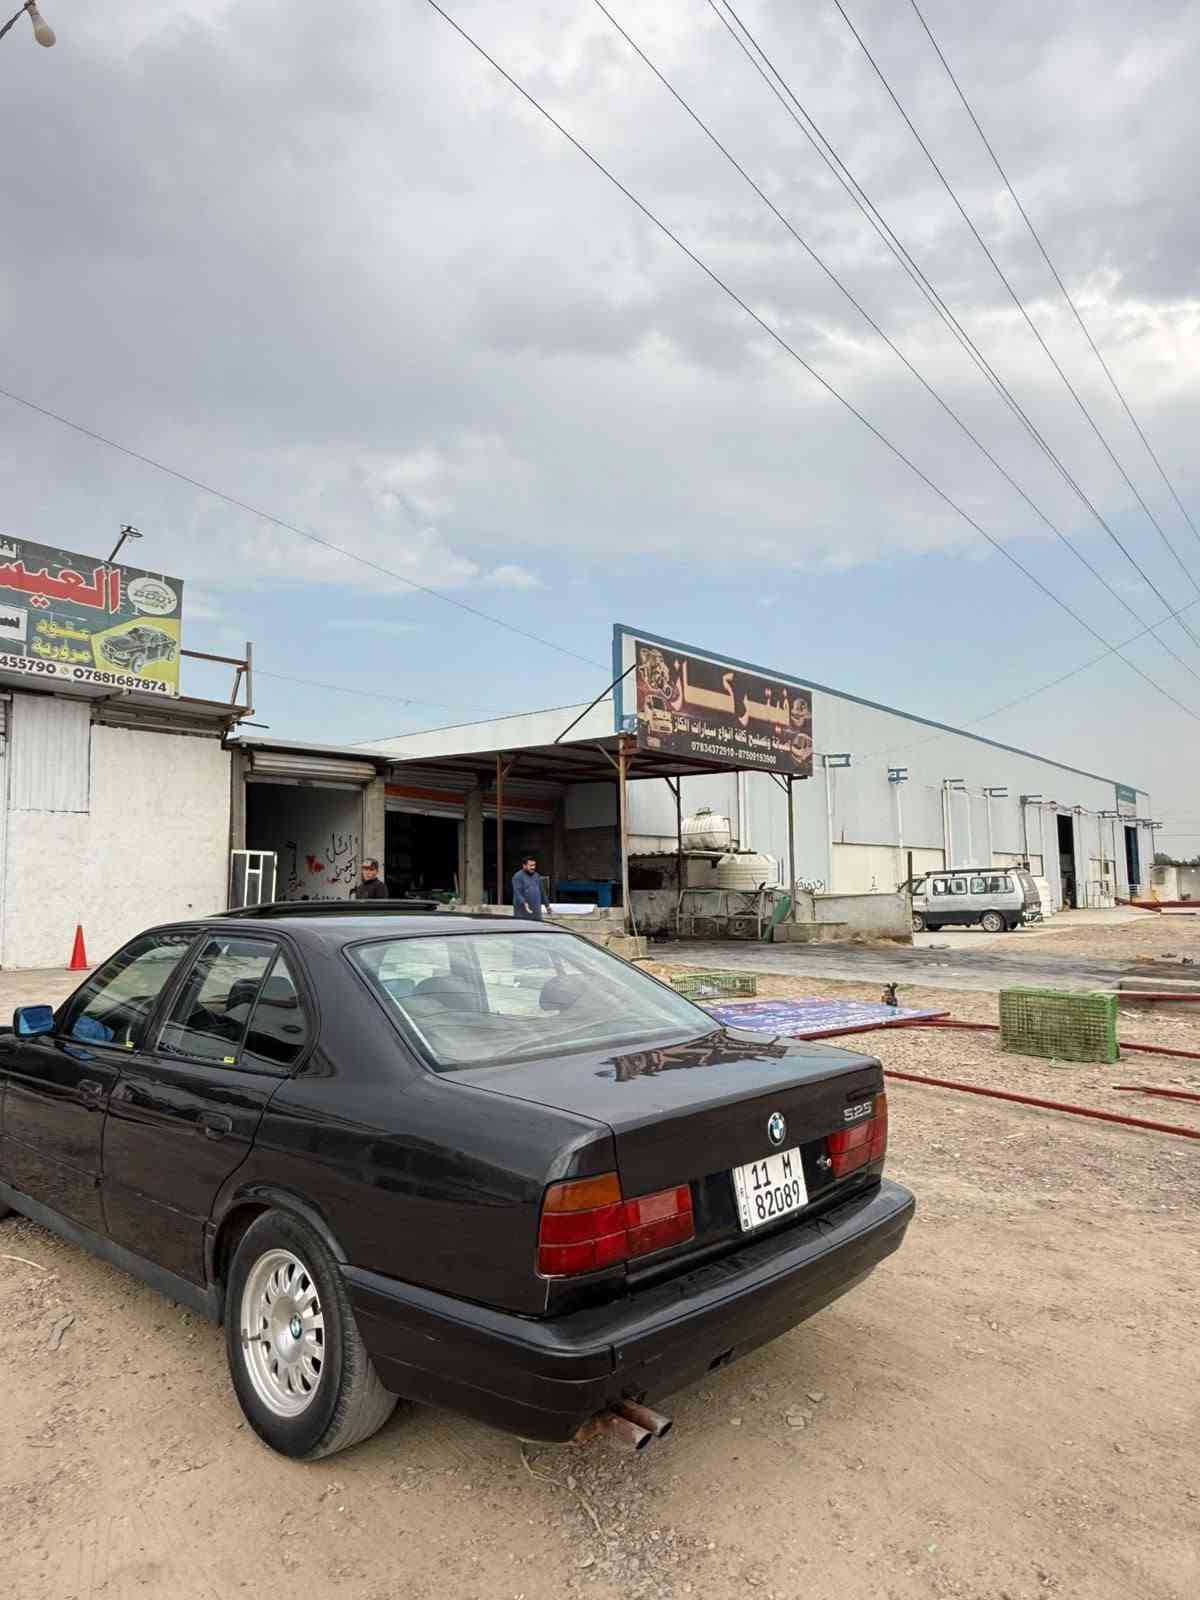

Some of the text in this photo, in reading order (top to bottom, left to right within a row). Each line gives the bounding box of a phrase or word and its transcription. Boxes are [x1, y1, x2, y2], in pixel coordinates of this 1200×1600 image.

[73, 668, 168, 692] 07881687874
[843, 1101, 873, 1121] 525
[751, 1152, 793, 1190] 11 M
[755, 1180, 800, 1219] 82089
